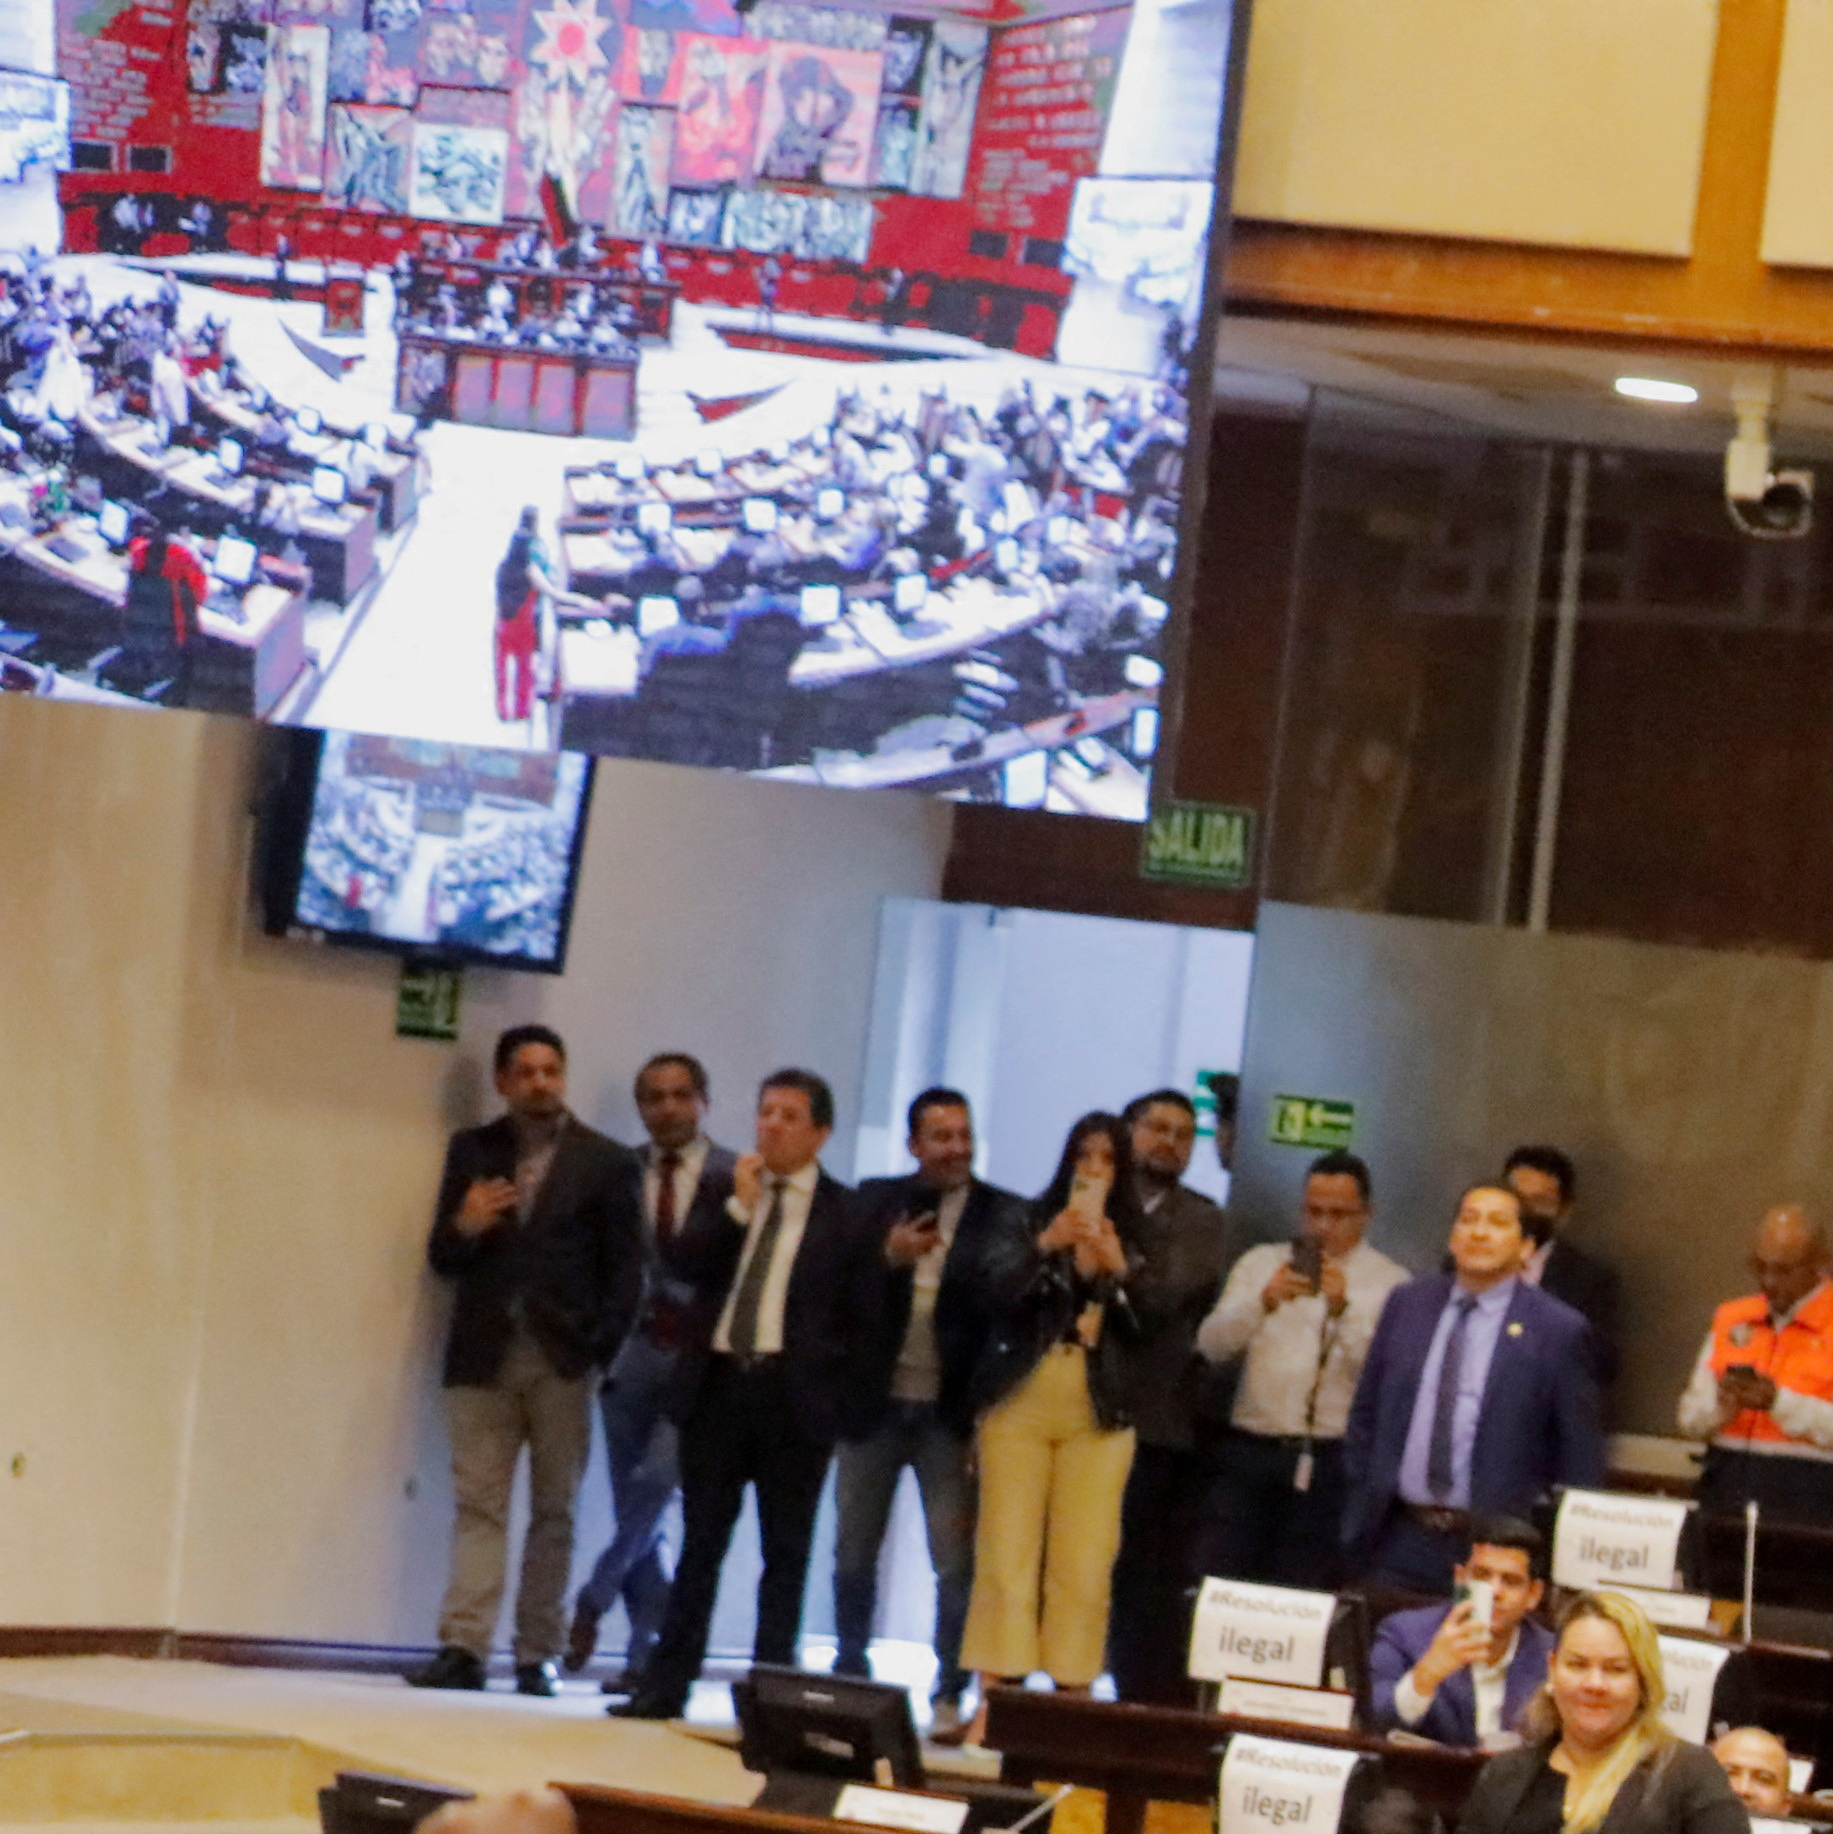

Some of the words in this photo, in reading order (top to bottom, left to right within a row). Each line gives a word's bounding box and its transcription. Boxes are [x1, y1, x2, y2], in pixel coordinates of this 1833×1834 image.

[1148, 810, 1243, 865] SALIDA
[1579, 1537, 1650, 1570] ilegal
[1219, 1627, 1294, 1665] ilegal
[1242, 1786, 1312, 1825] ilegal
